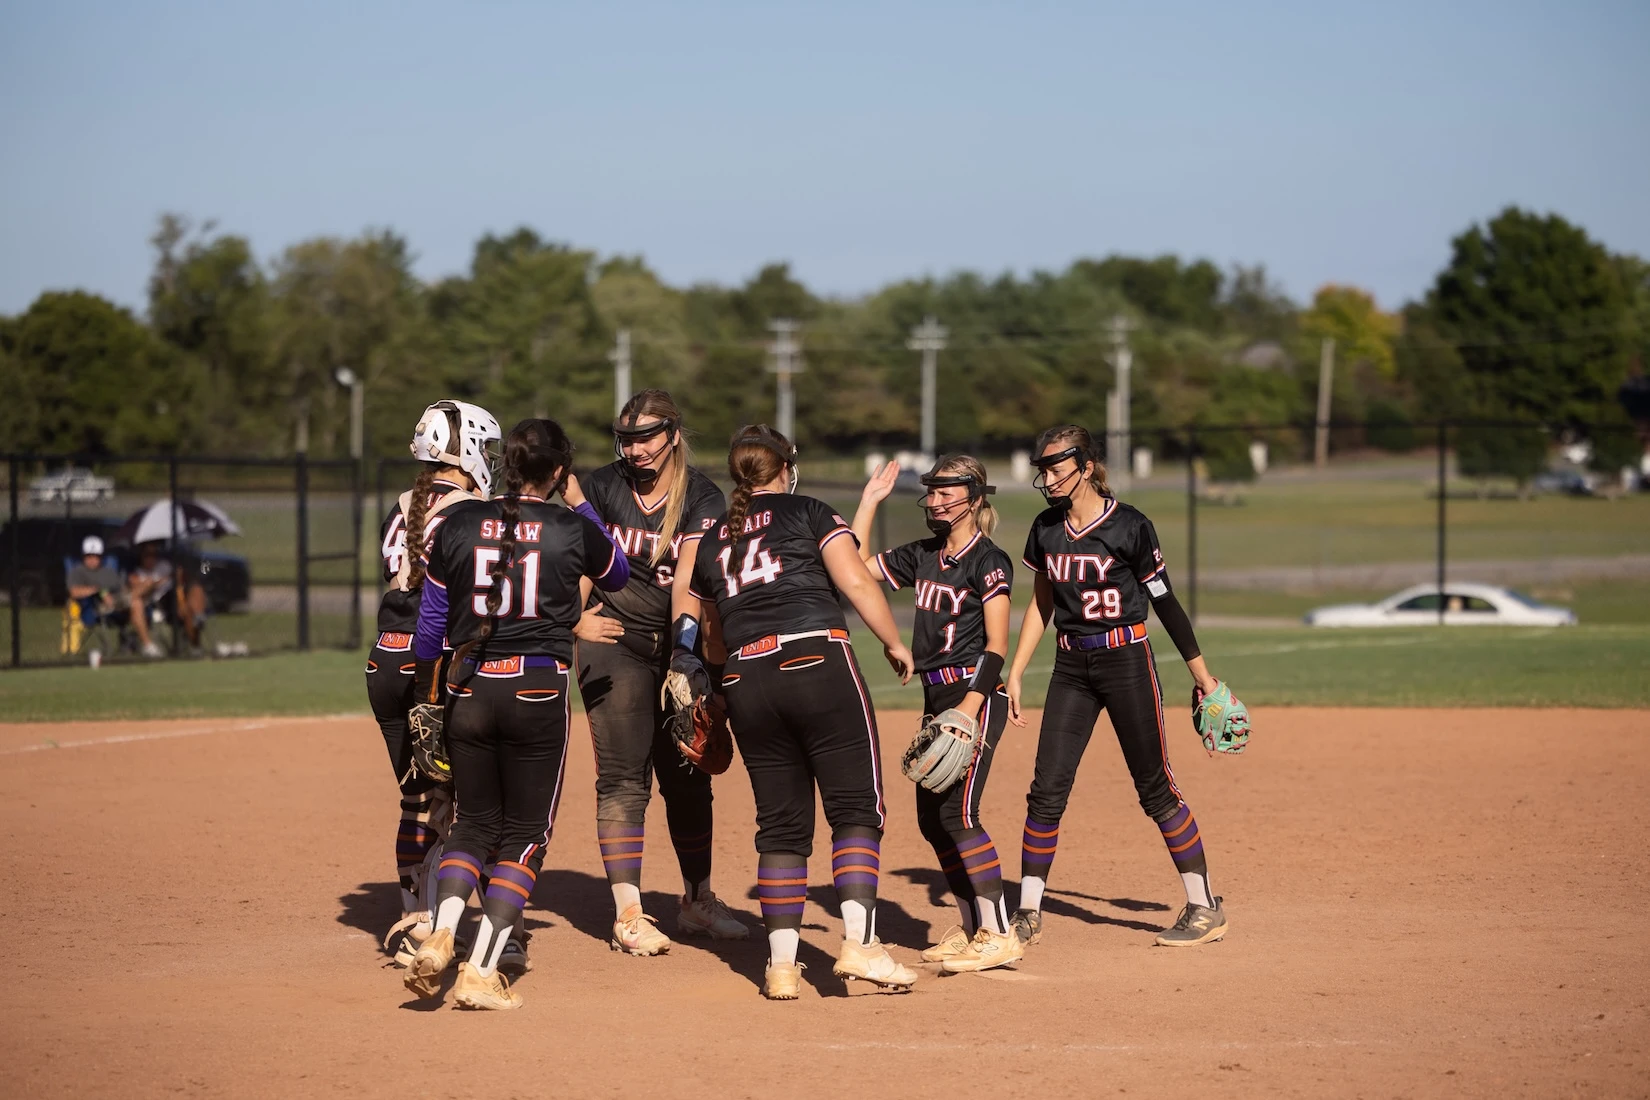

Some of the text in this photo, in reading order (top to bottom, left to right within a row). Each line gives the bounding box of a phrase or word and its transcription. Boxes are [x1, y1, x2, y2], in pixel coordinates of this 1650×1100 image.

[718, 509, 773, 541] CAIG
[471, 545, 542, 621] 51
[715, 533, 784, 599] 14
[1081, 586, 1125, 622] 29
[744, 637, 773, 653] UNITY
[939, 621, 957, 654] 1
